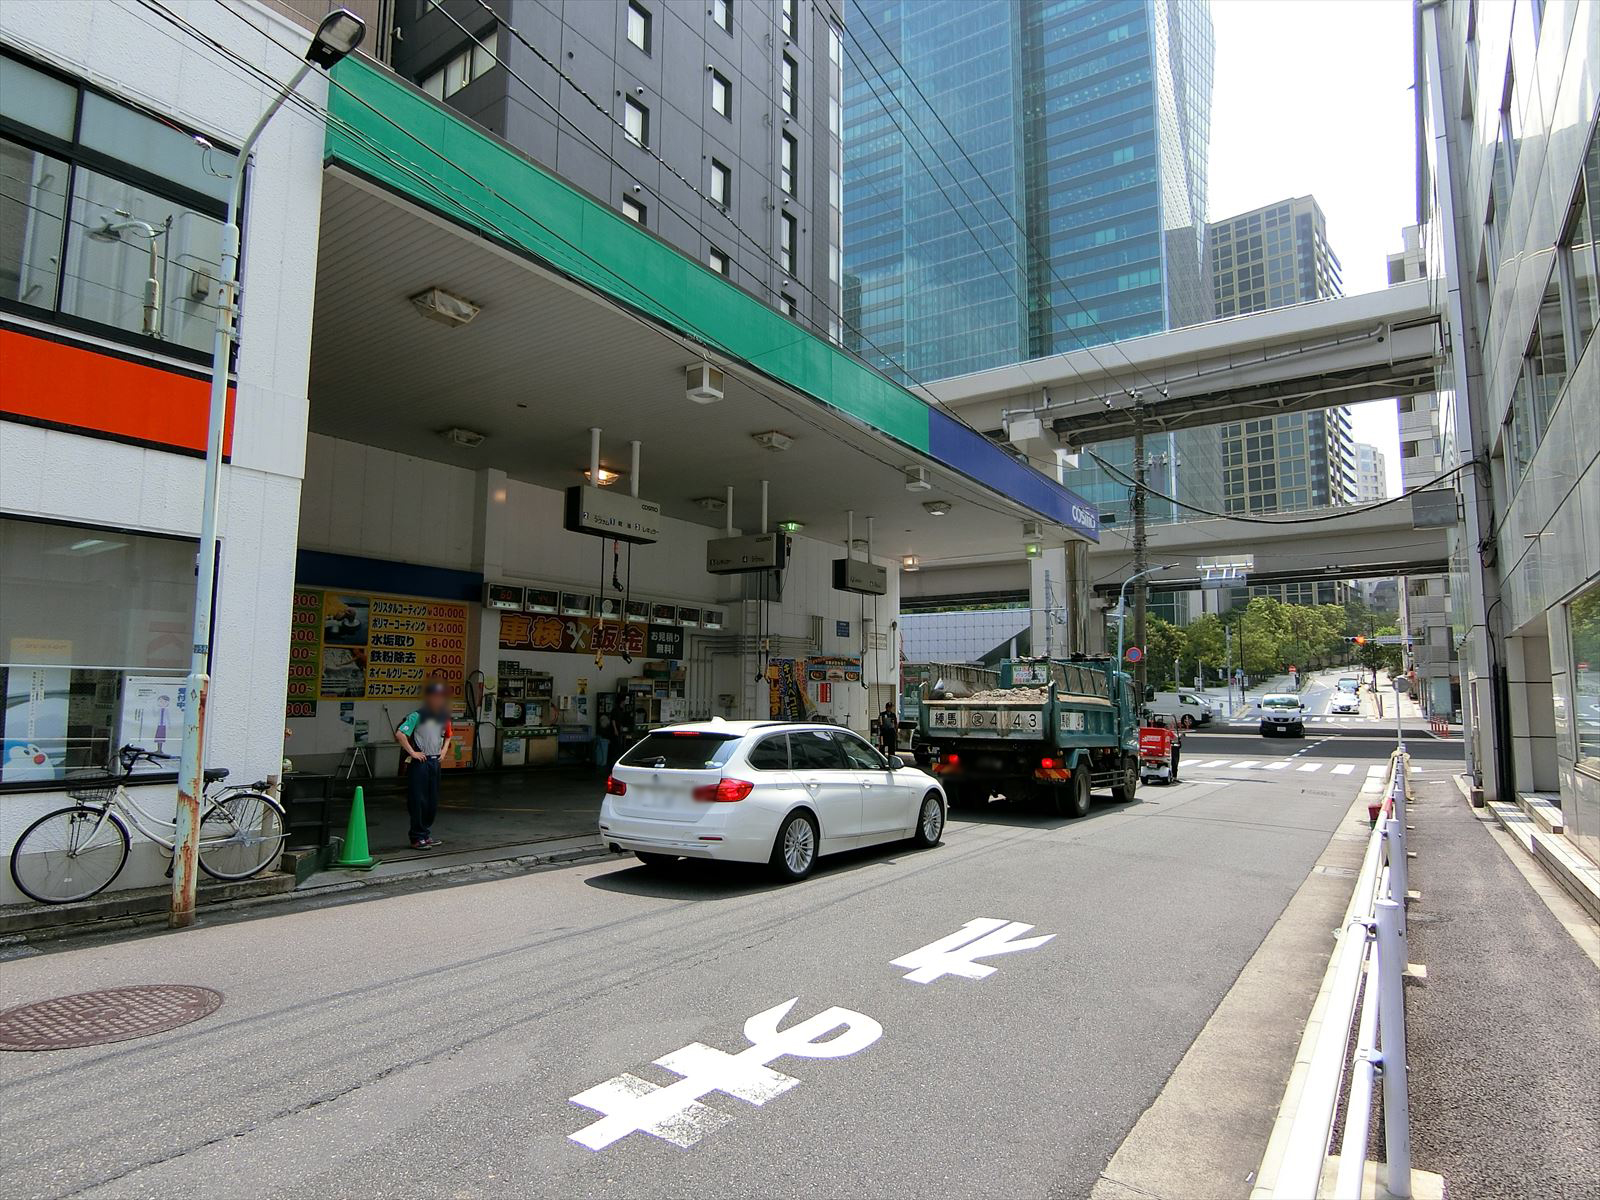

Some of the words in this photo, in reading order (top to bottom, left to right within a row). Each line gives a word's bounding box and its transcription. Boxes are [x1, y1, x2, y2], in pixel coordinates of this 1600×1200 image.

[372, 602, 426, 617] クリスタルコーティング
[372, 617, 426, 632] ポリマーコーティング
[500, 613, 564, 649] 車検
[371, 634, 414, 647] 水垢取り
[651, 631, 680, 643] お見積り
[370, 650, 416, 664] 鉄粉除去
[935, 712, 957, 727] 練馬
